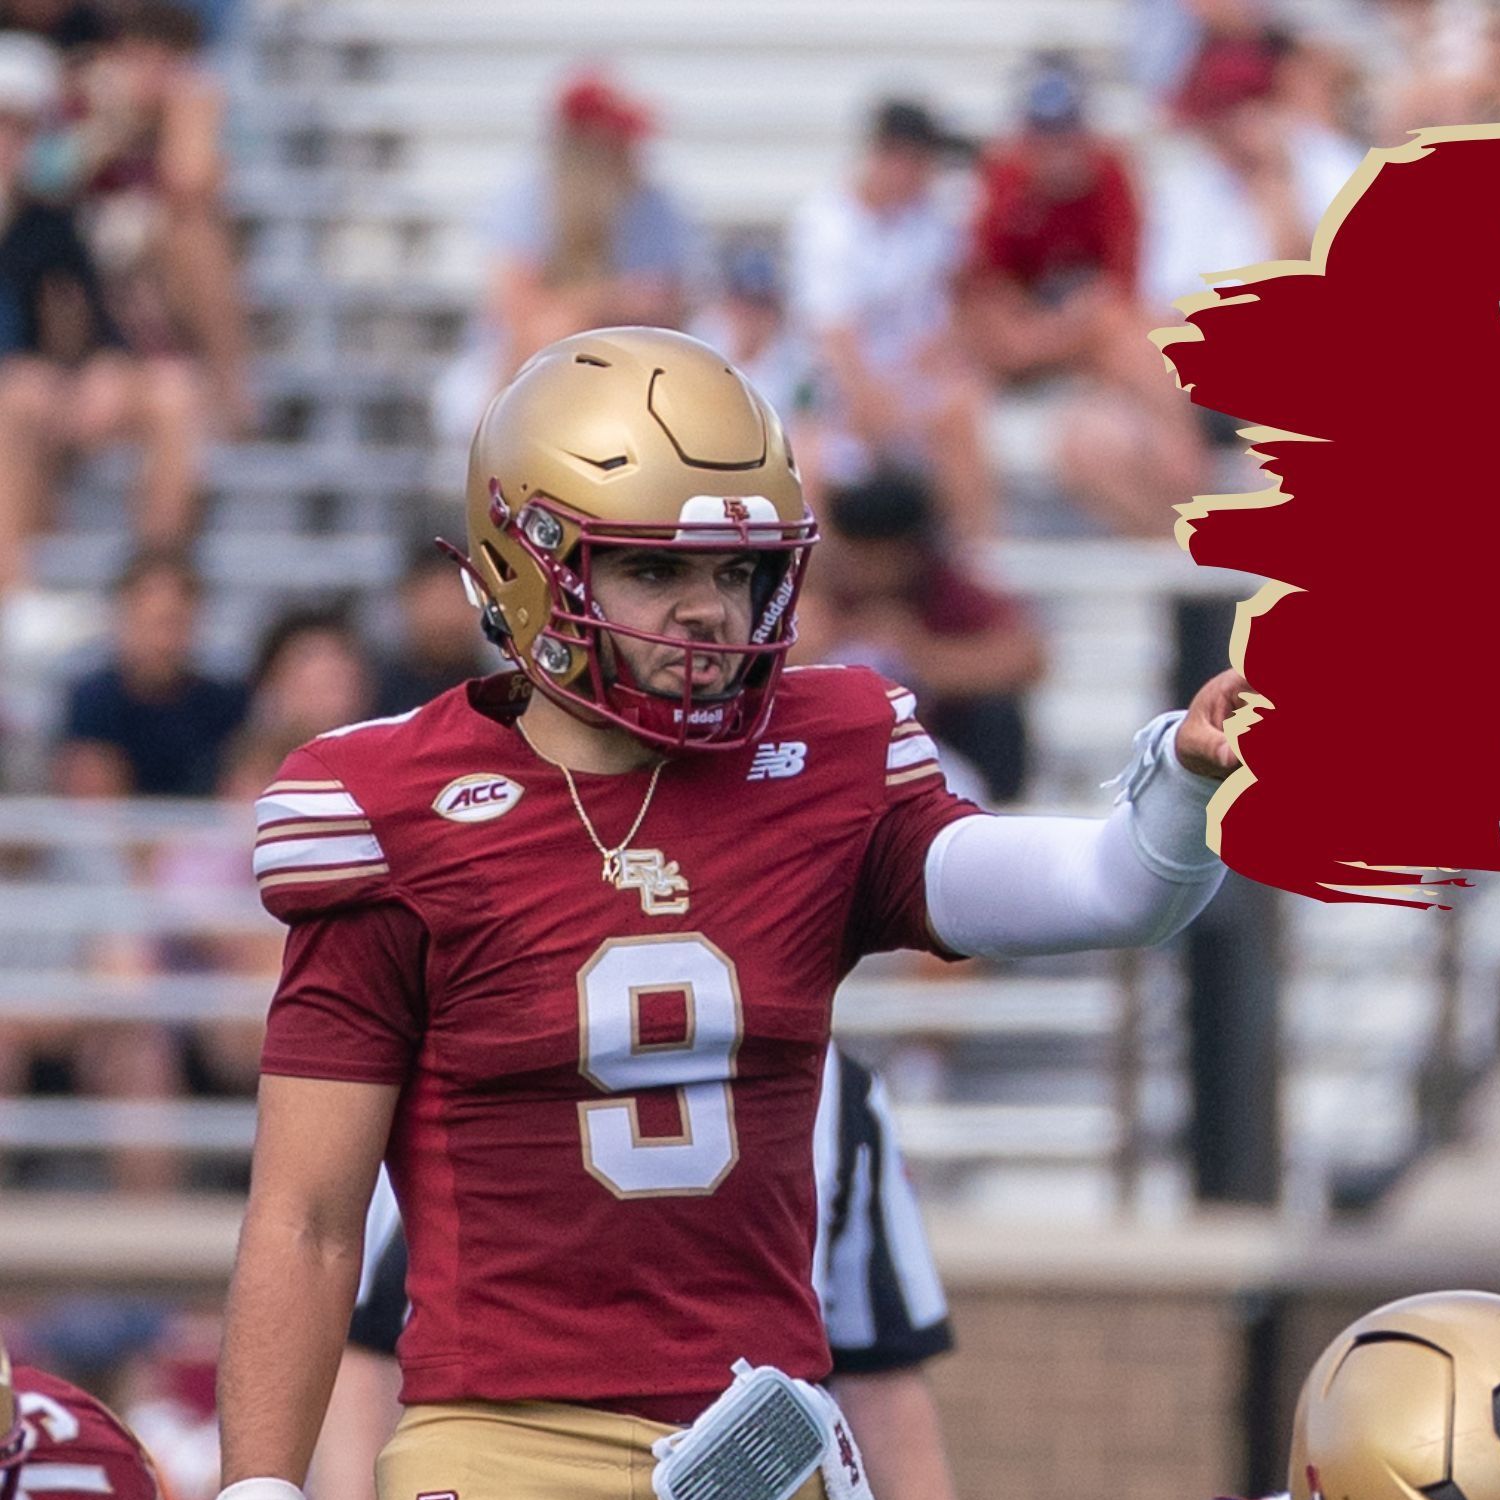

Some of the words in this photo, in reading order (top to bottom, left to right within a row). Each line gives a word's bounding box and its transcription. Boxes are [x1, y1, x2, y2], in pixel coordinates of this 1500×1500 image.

[673, 708, 724, 725] Rddell
[447, 782, 508, 811] ACC
[615, 849, 691, 916] BC
[576, 932, 743, 1200] 9
